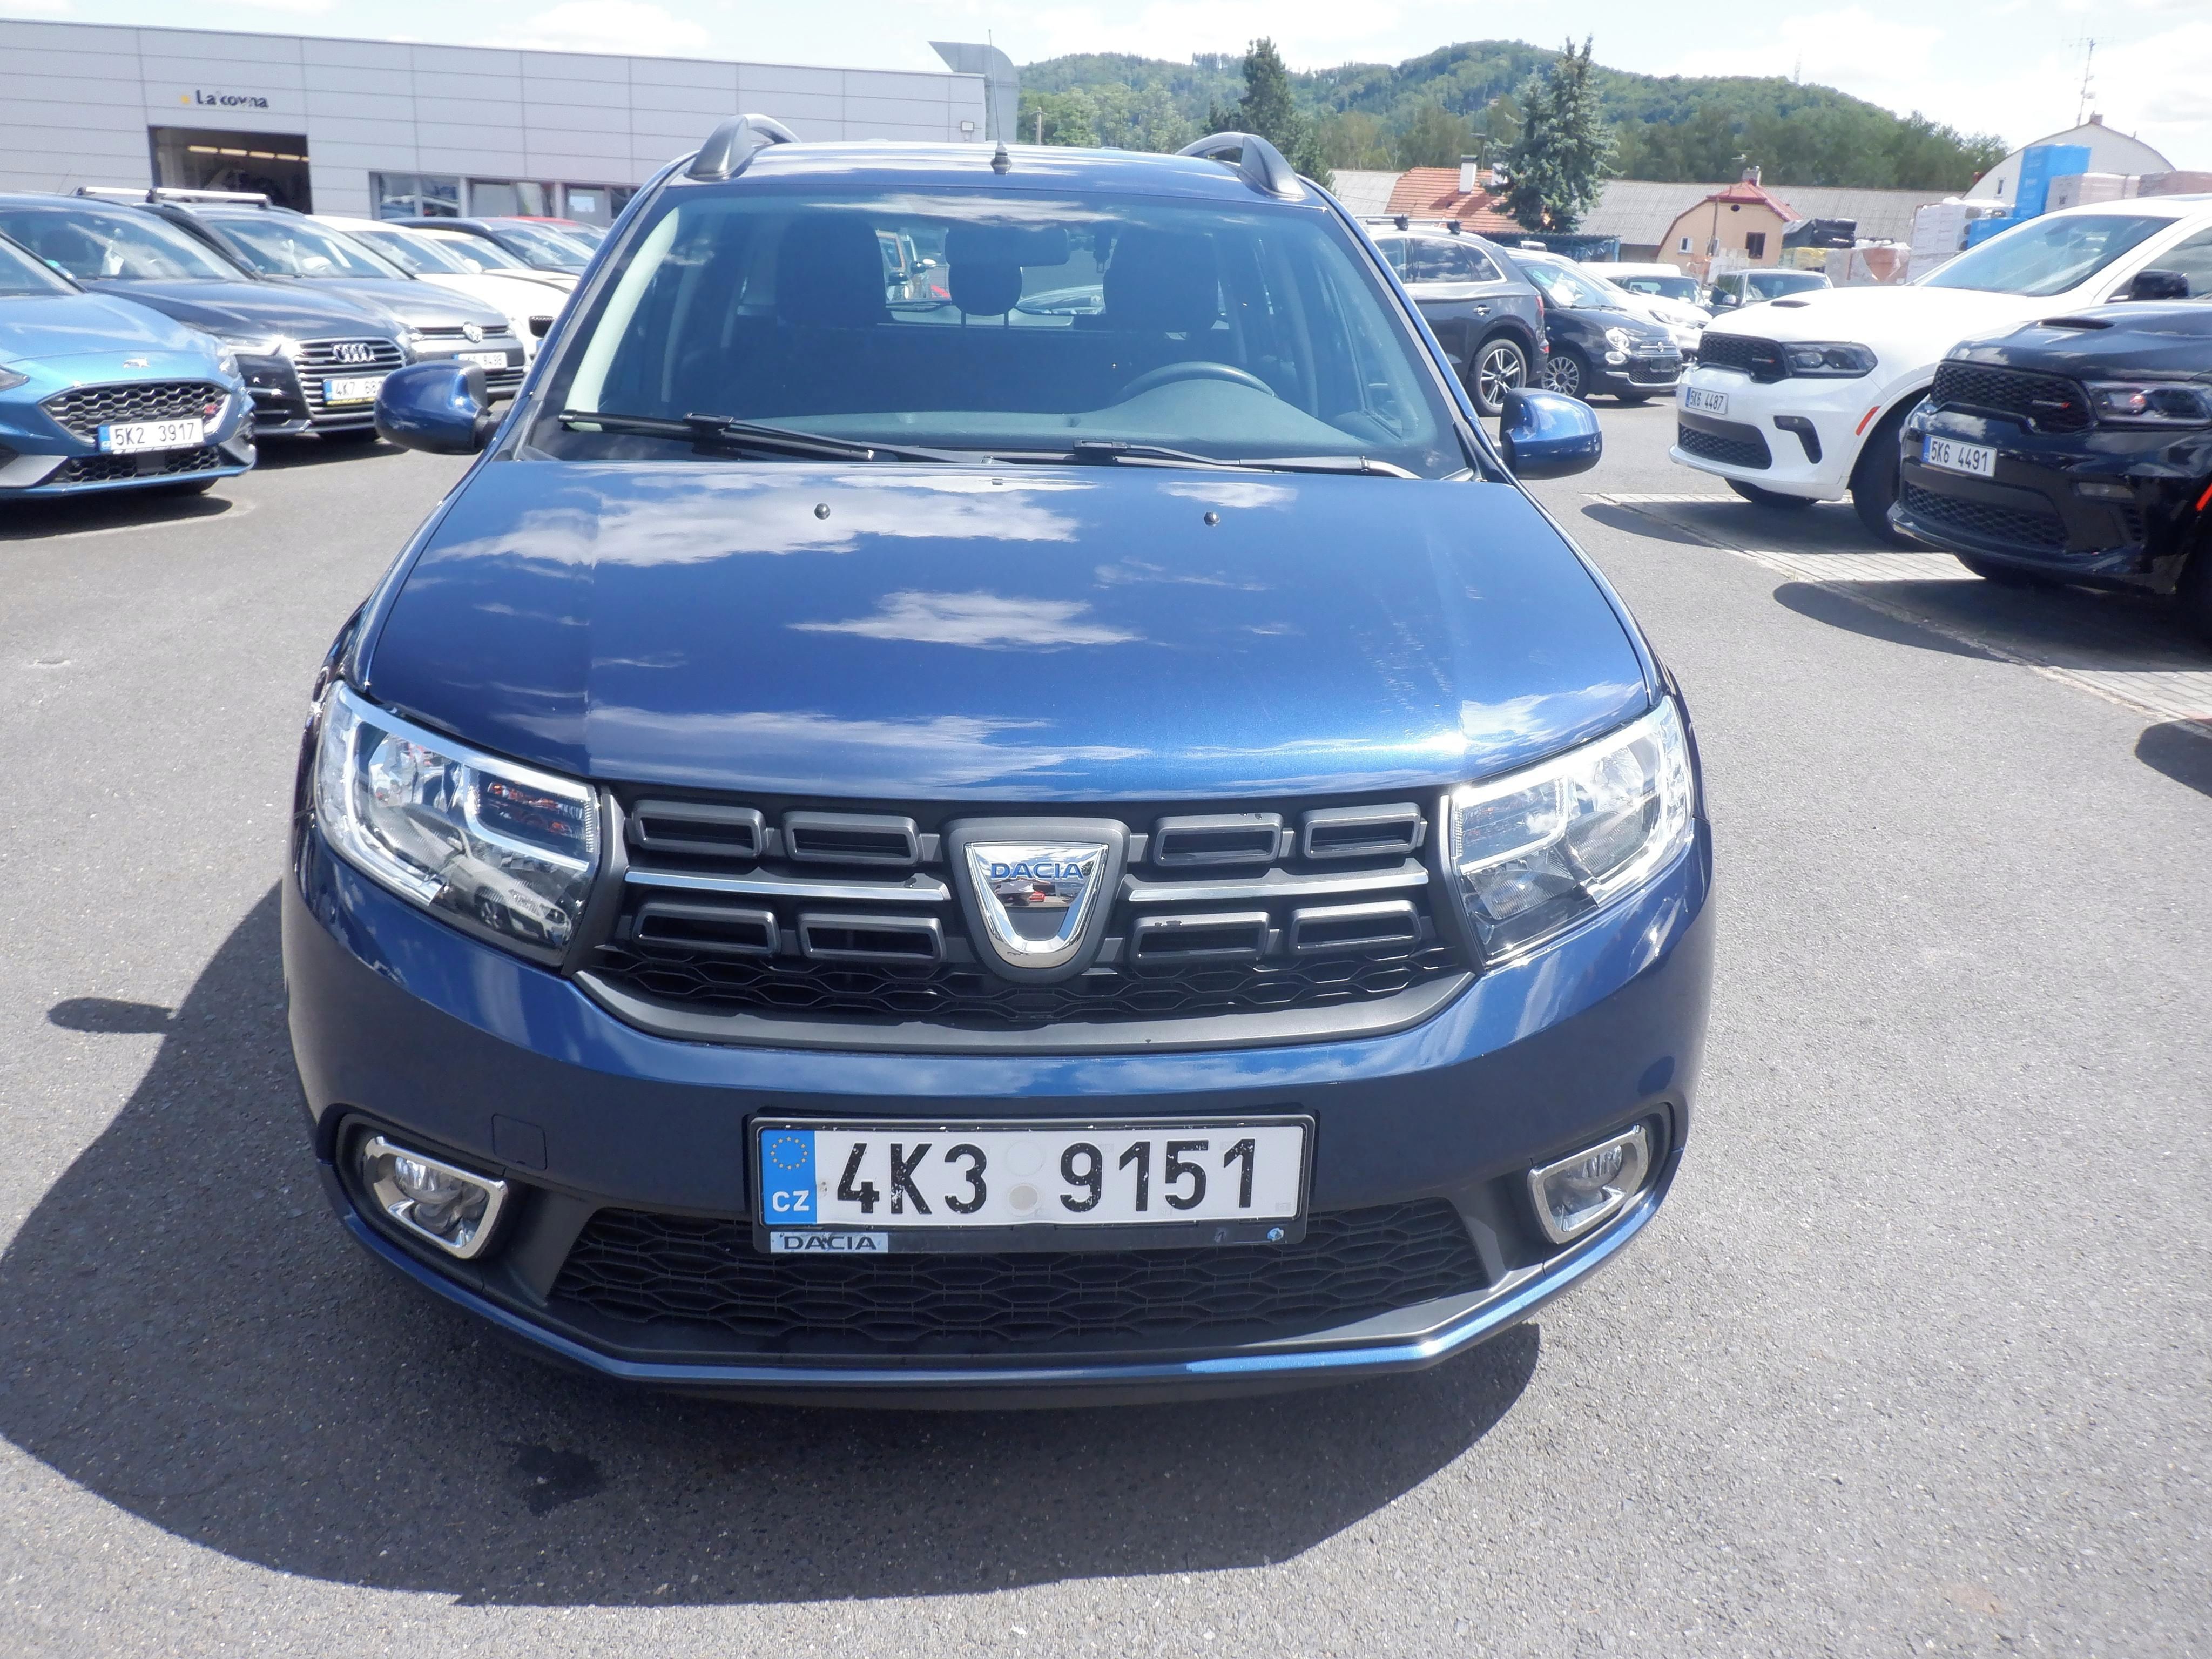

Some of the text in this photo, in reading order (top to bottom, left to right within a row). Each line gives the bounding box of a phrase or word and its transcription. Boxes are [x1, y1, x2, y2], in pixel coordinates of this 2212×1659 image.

[1704, 393, 1724, 410] 4487
[114, 422, 194, 446] 5K2 3917
[1931, 440, 1988, 472] 5K6 4491
[990, 862, 1084, 879] DACIA
[837, 1138, 1256, 1215] 4K3 9151
[772, 1190, 810, 1212] CZ
[784, 1235, 877, 1250] DACIA
